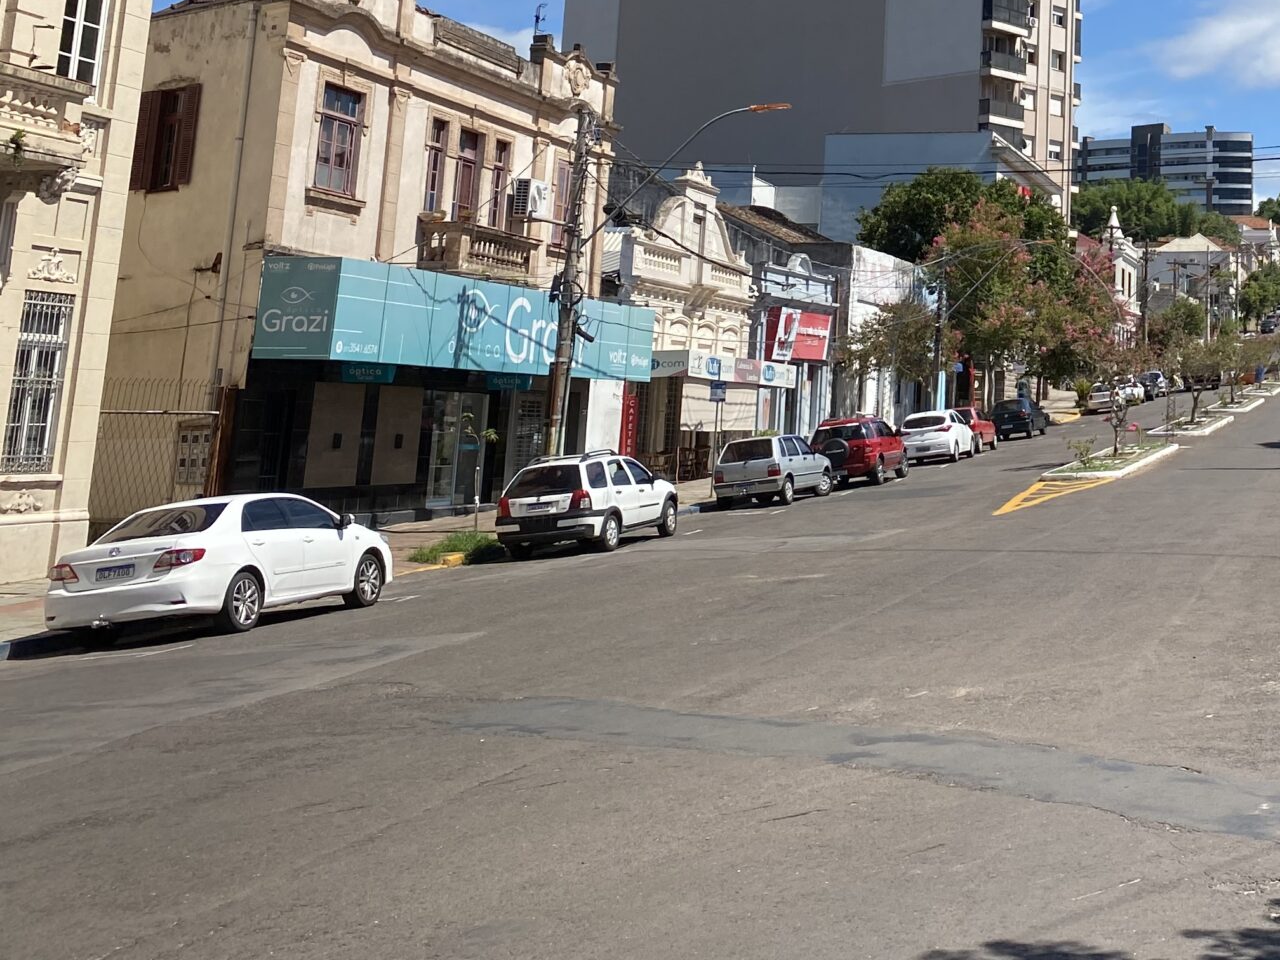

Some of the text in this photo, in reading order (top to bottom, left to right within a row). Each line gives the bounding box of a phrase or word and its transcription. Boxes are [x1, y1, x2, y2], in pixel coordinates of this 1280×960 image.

[261, 308, 329, 333] Grazi
[505, 296, 586, 368] Grai
[608, 349, 627, 364] voltz
[661, 360, 685, 368] com
[626, 400, 635, 456] CAFETER
